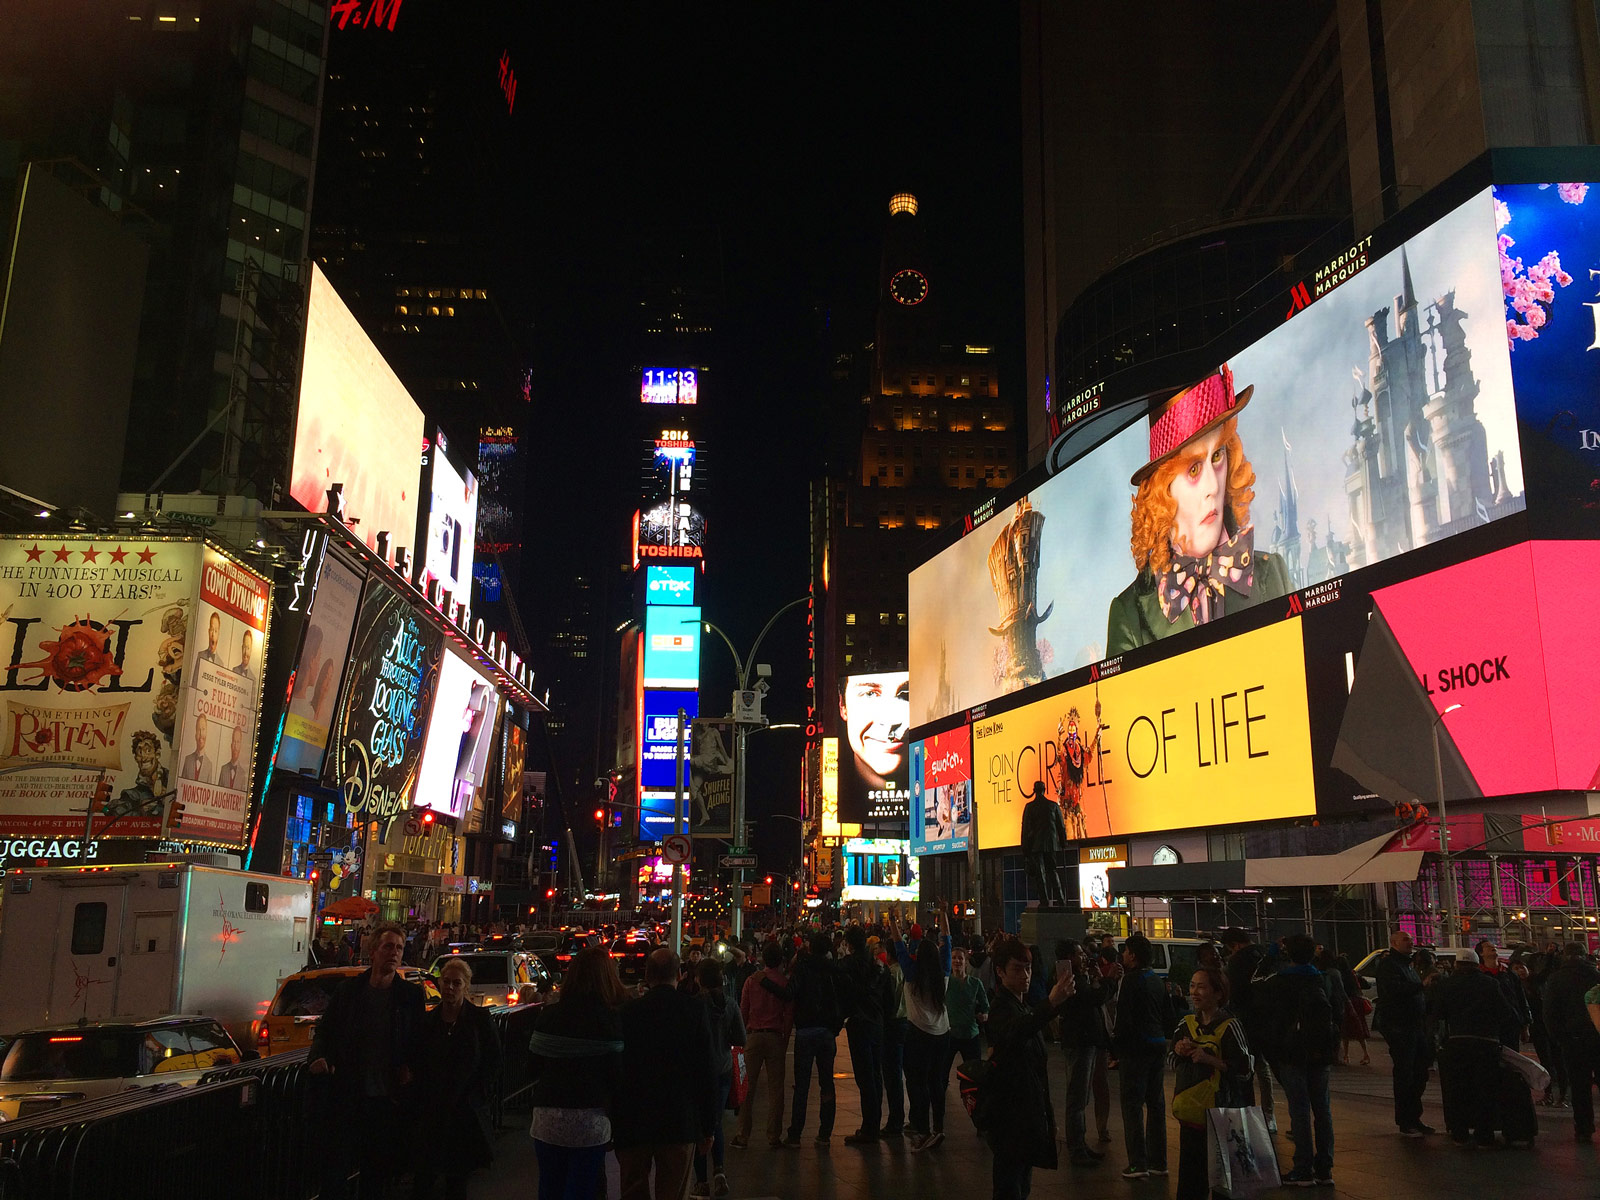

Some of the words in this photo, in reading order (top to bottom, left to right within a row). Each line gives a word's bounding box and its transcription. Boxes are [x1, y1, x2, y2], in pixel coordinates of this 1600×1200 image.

[1315, 235, 1373, 283] MARRIOTT
[1316, 255, 1367, 296] MARQUIS
[645, 370, 695, 386] 11:33
[1061, 381, 1105, 415] MARRIOTT
[1062, 398, 1099, 428] MARQUIS
[654, 440, 695, 448] TOSHIBA
[661, 430, 689, 441] 2016
[679, 453, 692, 491] THE
[974, 497, 996, 517] MARRIOTT
[974, 508, 994, 527] MARQUIS
[639, 546, 703, 558] TOSHIBA
[0, 566, 24, 579] HE
[29, 566, 108, 581] FUNNIEST
[112, 568, 183, 582] MUSICAL
[18, 582, 41, 598] IN
[46, 583, 83, 599] 400
[205, 567, 231, 602] COMIC
[660, 579, 691, 591] TDK
[1304, 579, 1343, 599] MARRIOTT
[1305, 590, 1339, 608] MARQUIS
[449, 595, 536, 691] BROADWAY
[1100, 656, 1123, 669] MARRIOTT
[1100, 665, 1121, 677] MARQUIS
[214, 677, 227, 687] TYLER
[381, 656, 408, 690] THROUGH
[806, 677, 814, 688] &
[1438, 655, 1510, 692] SHOCK
[212, 688, 238, 708] FULLY
[23, 707, 112, 720] SOMETHING
[197, 699, 247, 727] COMMITTED
[983, 725, 993, 738] LION
[993, 722, 1004, 735] KING
[1126, 707, 1177, 779] OF
[1195, 685, 1269, 768] LIFE
[370, 719, 407, 768] GLASS
[931, 751, 960, 776] swatch
[988, 750, 1014, 783] JOIN
[1016, 724, 1112, 800] CIRLE
[71, 775, 116, 783] ALAIN
[703, 778, 731, 797] SHUFFLE
[0, 789, 17, 798] HE
[19, 789, 48, 798] BOOK
[50, 790, 65, 799] OF
[707, 792, 731, 811] ALONG
[868, 789, 910, 799] SCREAM
[992, 779, 1013, 805] THE
[182, 816, 206, 826] BROADWAY
[206, 819, 217, 828] THRU
[158, 841, 186, 854] GIFTS
[1089, 846, 1118, 860] INVICTA
